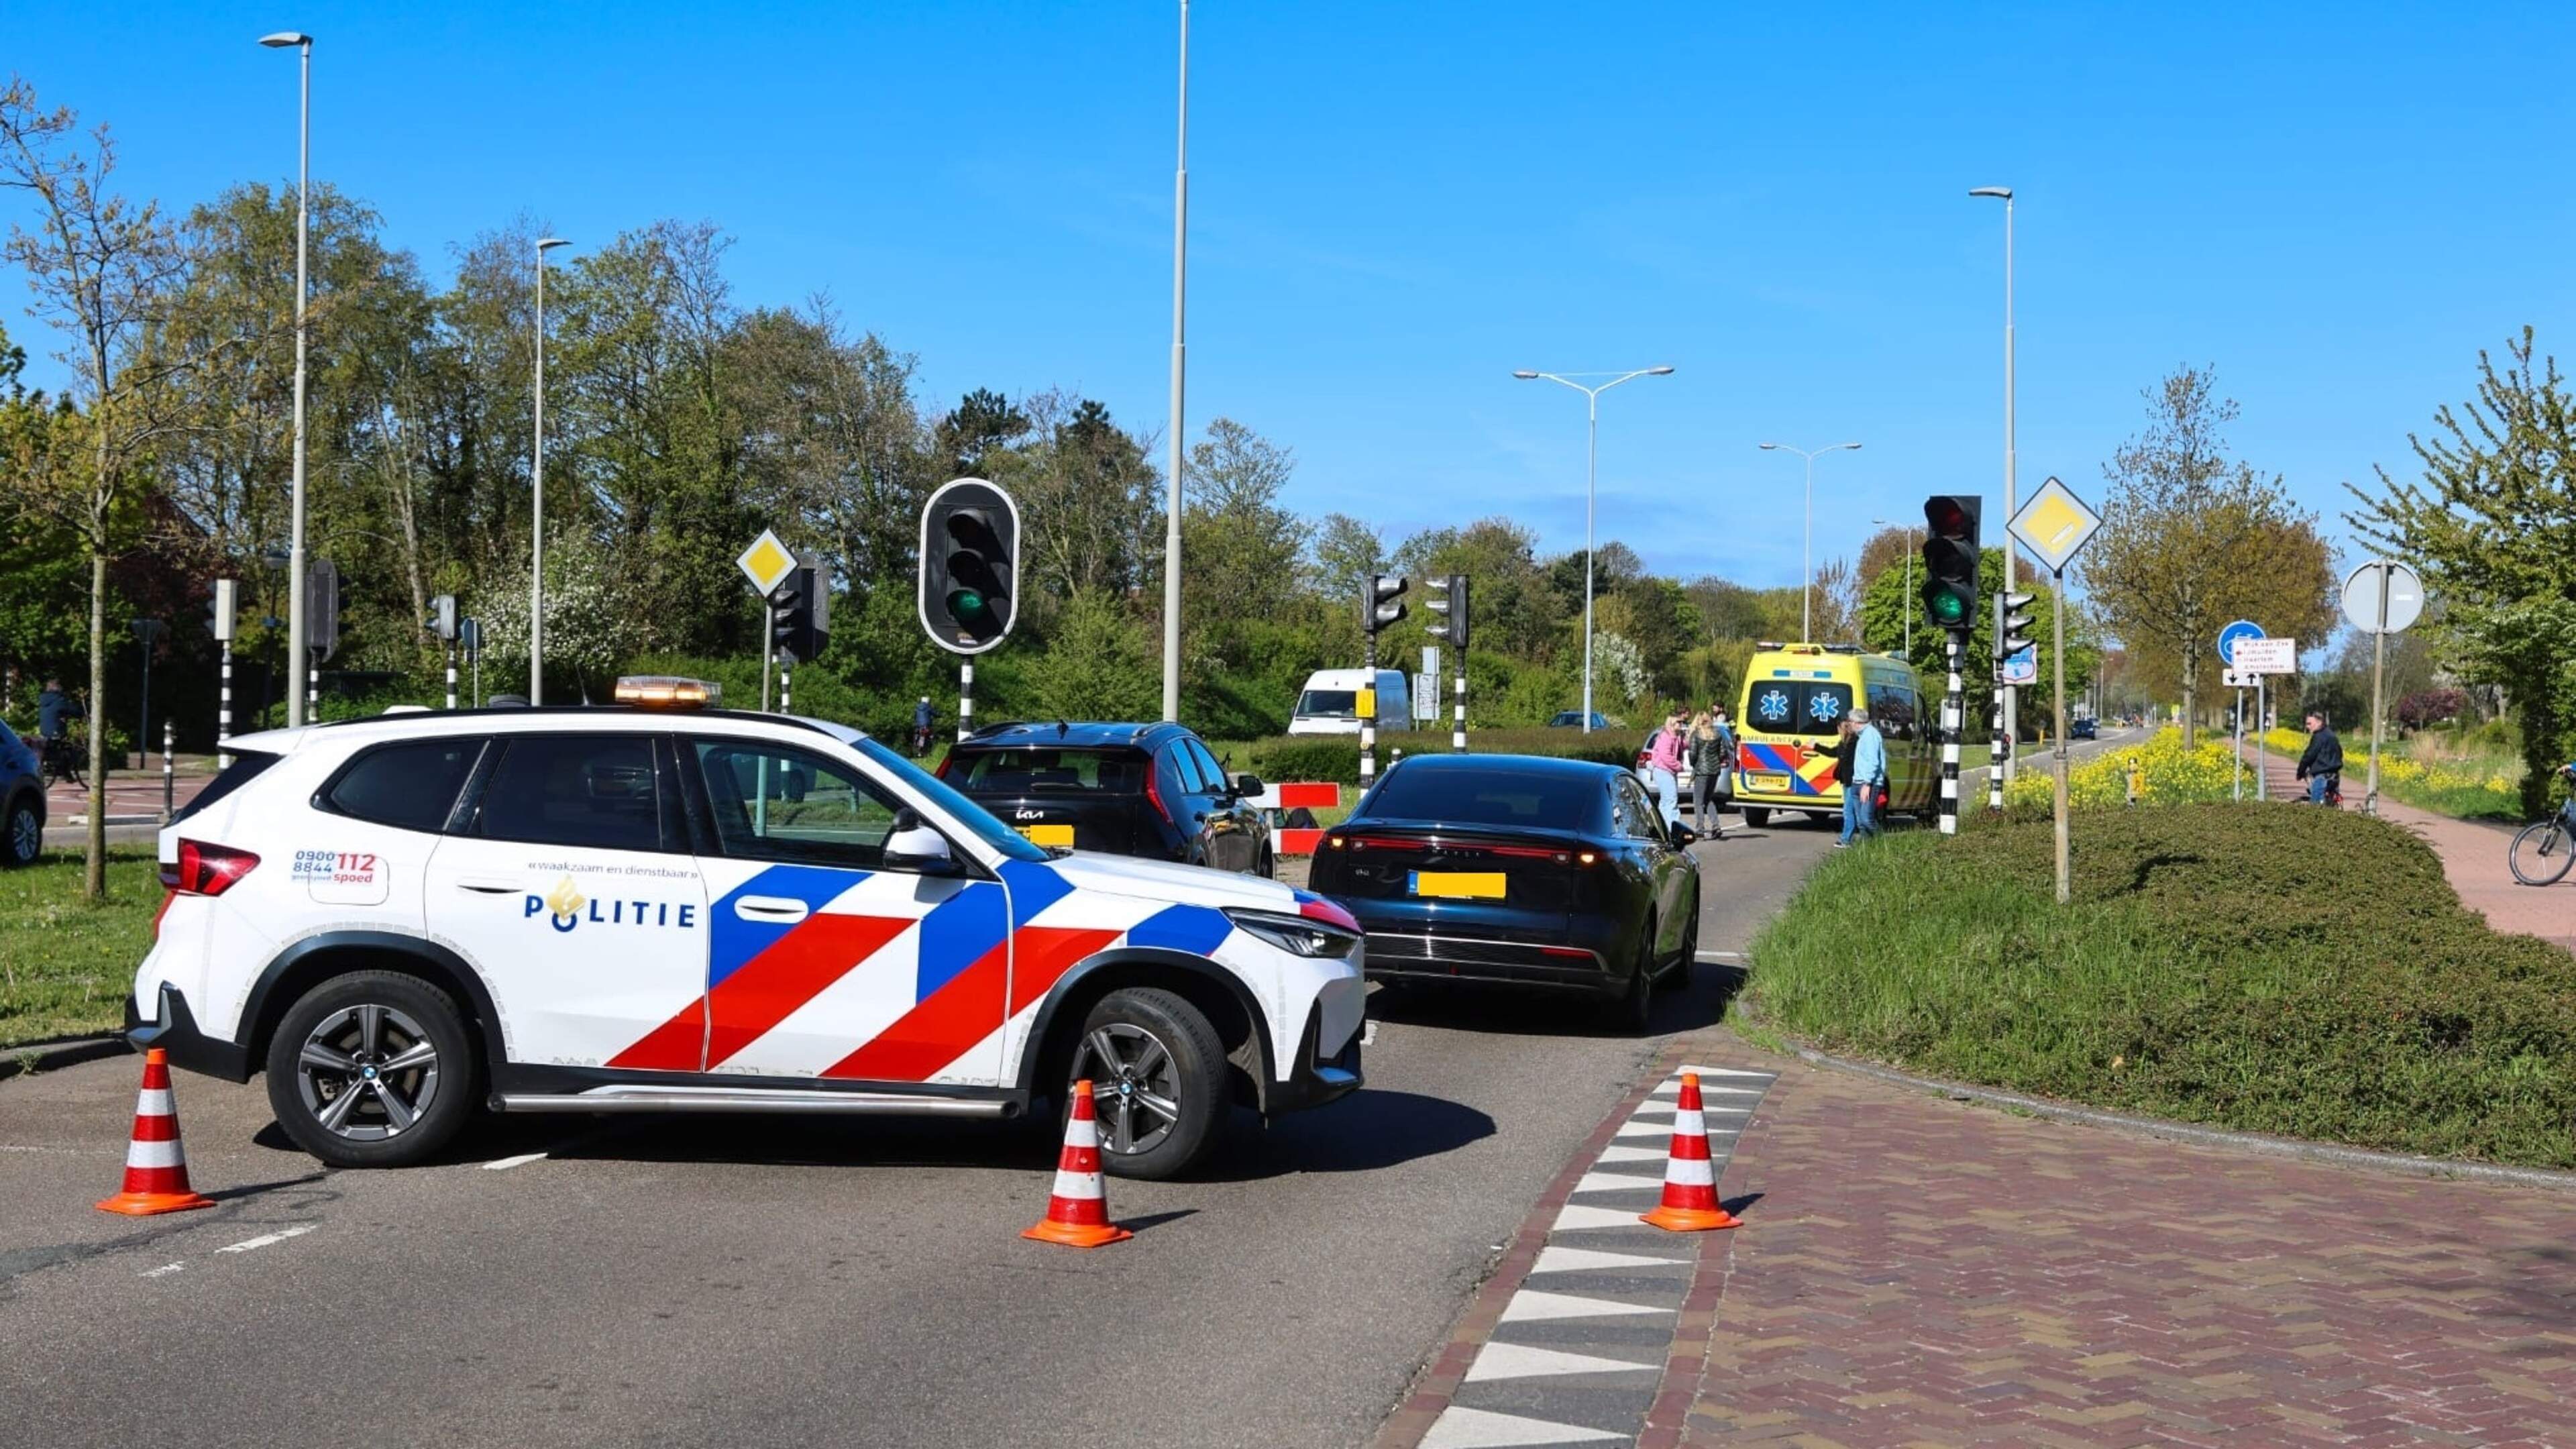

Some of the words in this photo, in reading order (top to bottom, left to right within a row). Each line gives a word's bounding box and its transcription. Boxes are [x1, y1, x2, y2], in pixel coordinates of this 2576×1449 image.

[296, 851, 335, 861] 0900
[337, 853, 376, 871] 112
[293, 861, 332, 873] 8844
[333, 873, 373, 883] spoed
[524, 894, 696, 933] POLITIE
